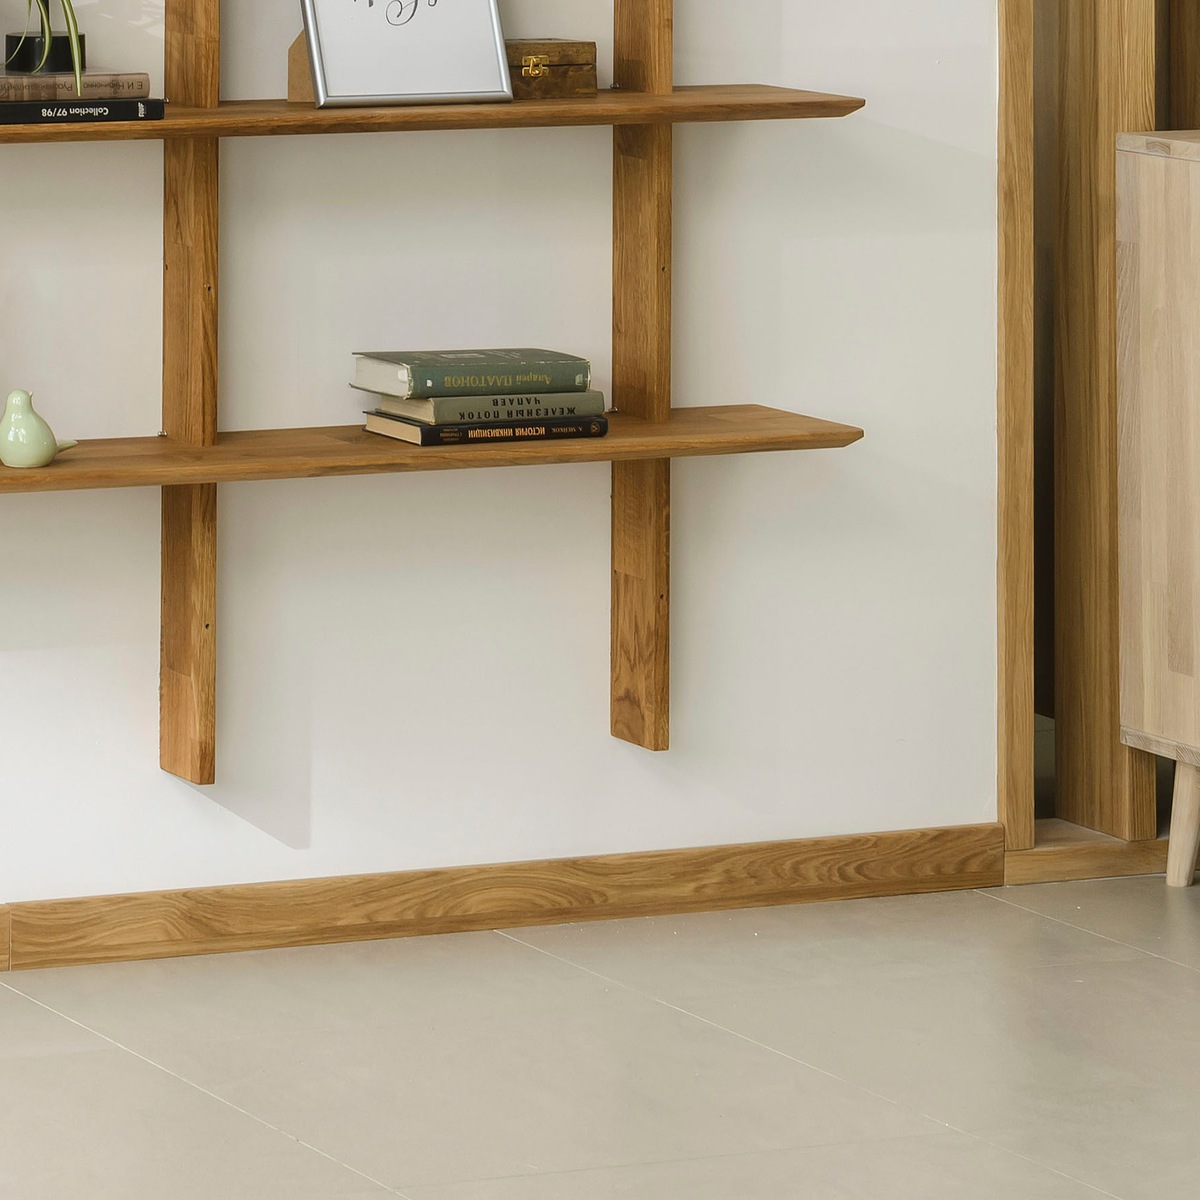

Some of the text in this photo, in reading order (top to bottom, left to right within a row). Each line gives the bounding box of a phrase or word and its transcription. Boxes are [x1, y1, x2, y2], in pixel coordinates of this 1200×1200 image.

[41, 106, 110, 118] Collection 97/98
[444, 371, 552, 388] Андрей ПЛАТОНОВ
[492, 397, 541, 407] ЧАПАЕВ
[458, 406, 576, 421] ЖЕЛЕЗНЫЙ ПОТОК
[468, 426, 514, 439] ИНКВИЗИЦИИ
[515, 425, 546, 437] ИСТОРИЯ
